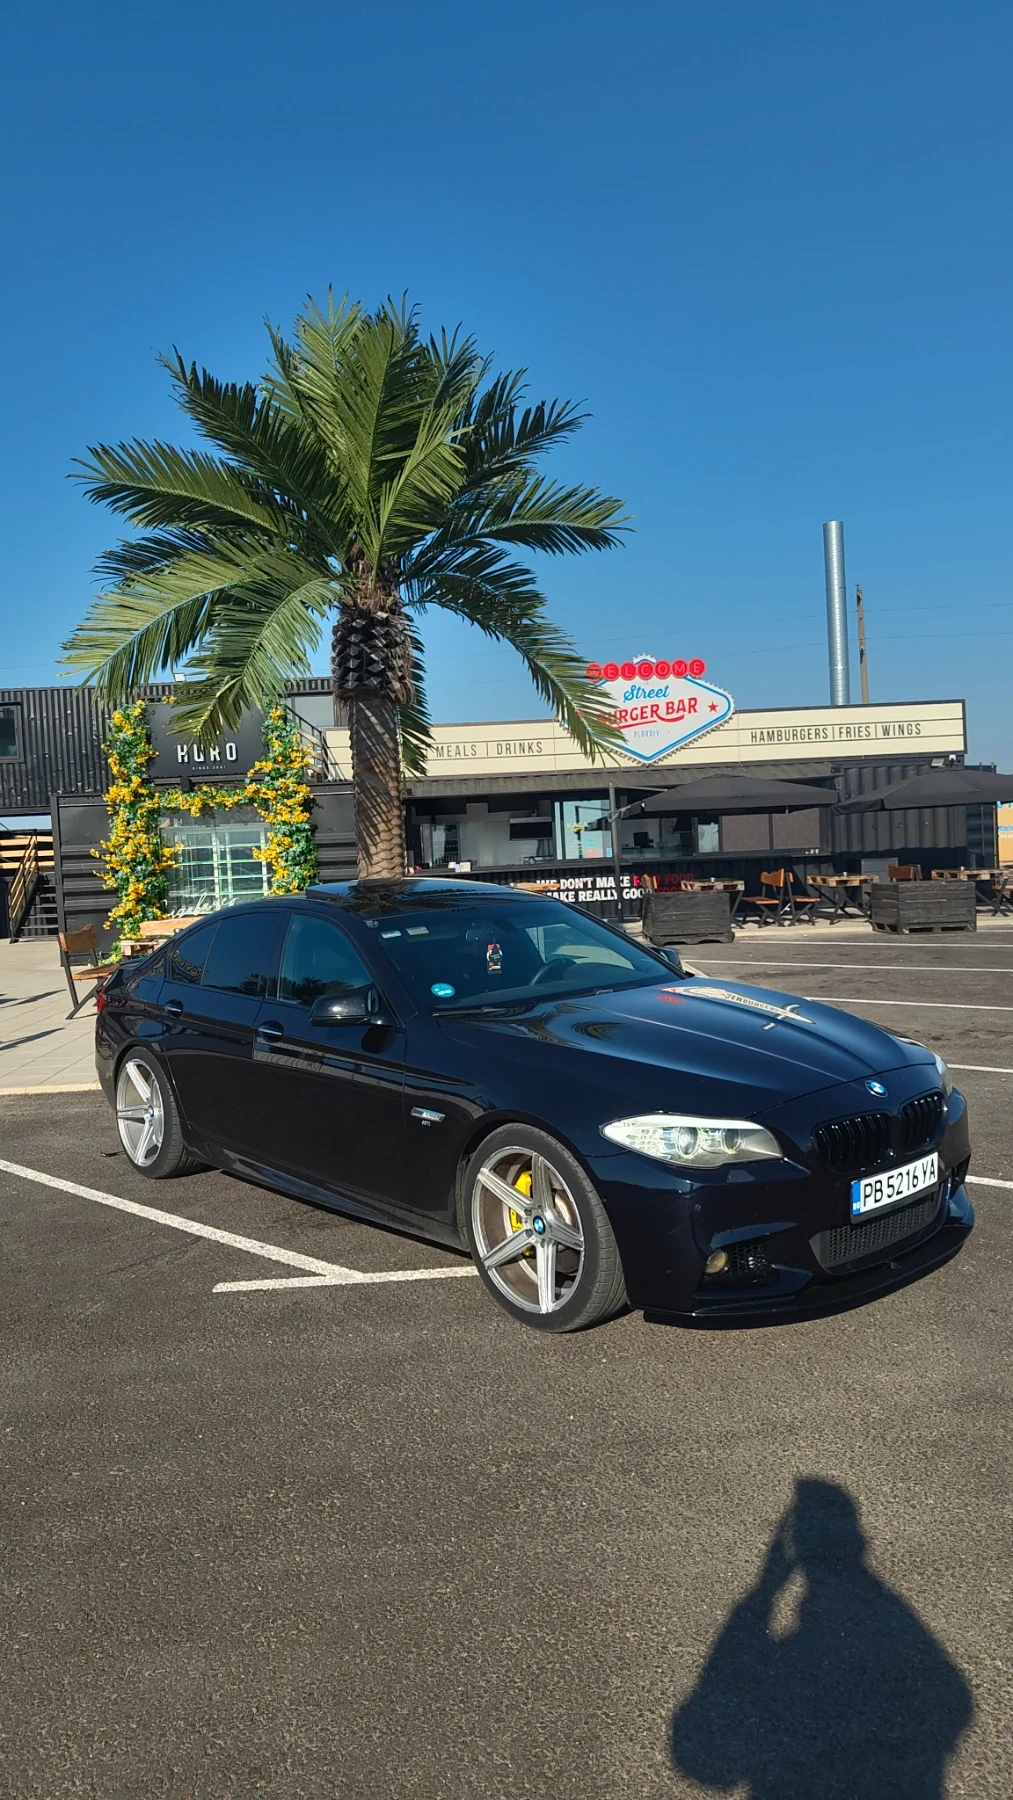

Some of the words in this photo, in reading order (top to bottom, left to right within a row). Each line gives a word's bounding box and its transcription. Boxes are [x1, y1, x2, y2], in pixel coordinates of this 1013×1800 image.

[623, 684, 670, 703] Street
[665, 697, 698, 716] BAR
[633, 729, 660, 738] PLOVDIV
[750, 727, 829, 744] HAMBURGERS
[838, 725, 871, 739] FRIES
[881, 722, 922, 737] WINGS
[436, 743, 477, 758] MEALS
[496, 741, 542, 756] DRINKS
[560, 877, 594, 890] DON'T
[863, 1179, 883, 1207] PB
[887, 1165, 919, 1199] 5216
[922, 1157, 936, 1185] YA
